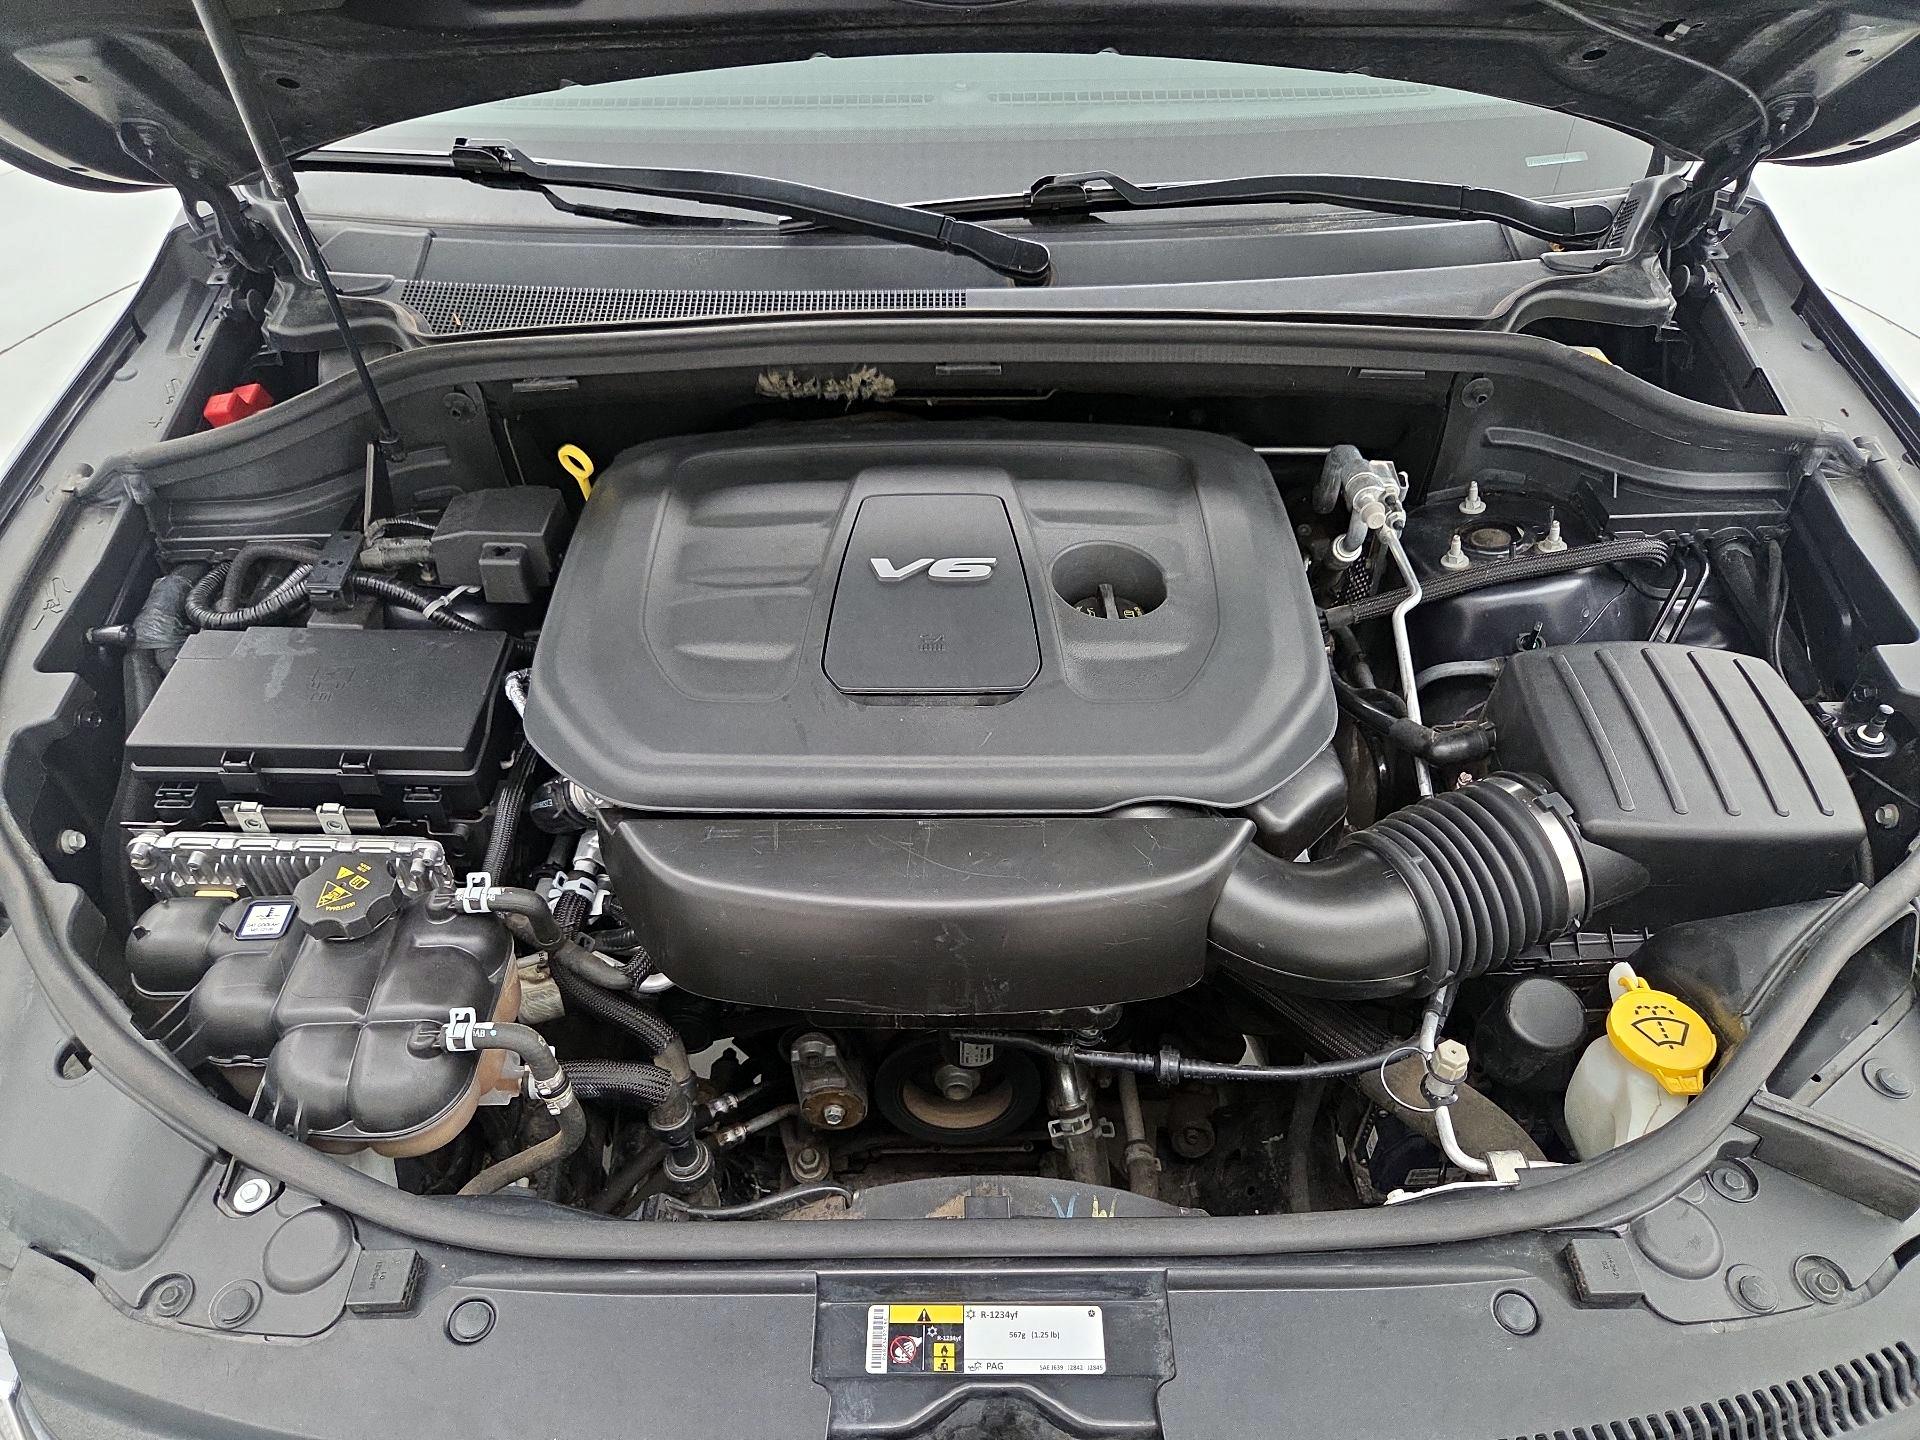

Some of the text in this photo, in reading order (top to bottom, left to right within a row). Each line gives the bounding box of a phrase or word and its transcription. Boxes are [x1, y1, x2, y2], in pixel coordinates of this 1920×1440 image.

[870, 557, 997, 582] V6
[980, 1310, 1019, 1320] R-1234yf
[1008, 1331, 1060, 1340] 567g (1.25 lb)
[986, 1362, 1004, 1371] PAG
